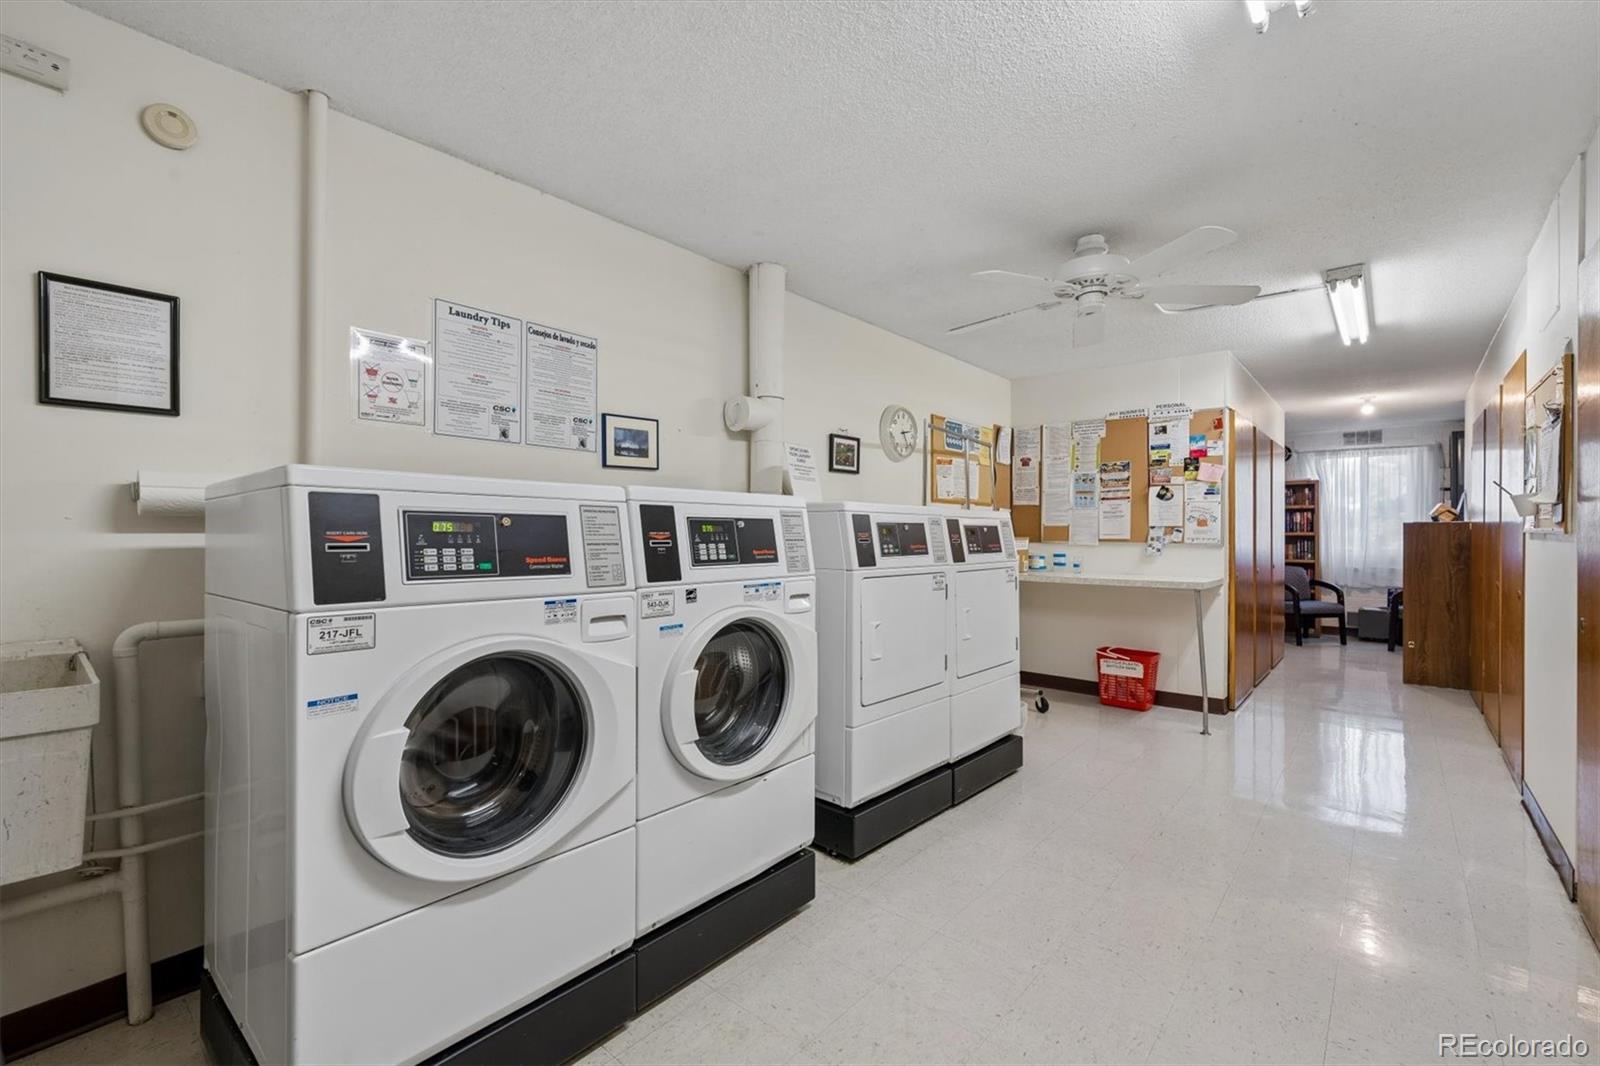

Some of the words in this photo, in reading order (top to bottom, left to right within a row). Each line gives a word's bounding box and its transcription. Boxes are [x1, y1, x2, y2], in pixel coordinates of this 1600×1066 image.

[448, 306, 489, 325] Laundry
[490, 317, 511, 330] Tips
[528, 326, 552, 340] Consejos
[552, 332, 559, 341] de
[576, 340, 580, 348] y
[493, 405, 511, 413] CSC
[319, 628, 362, 640] 217-JFL
